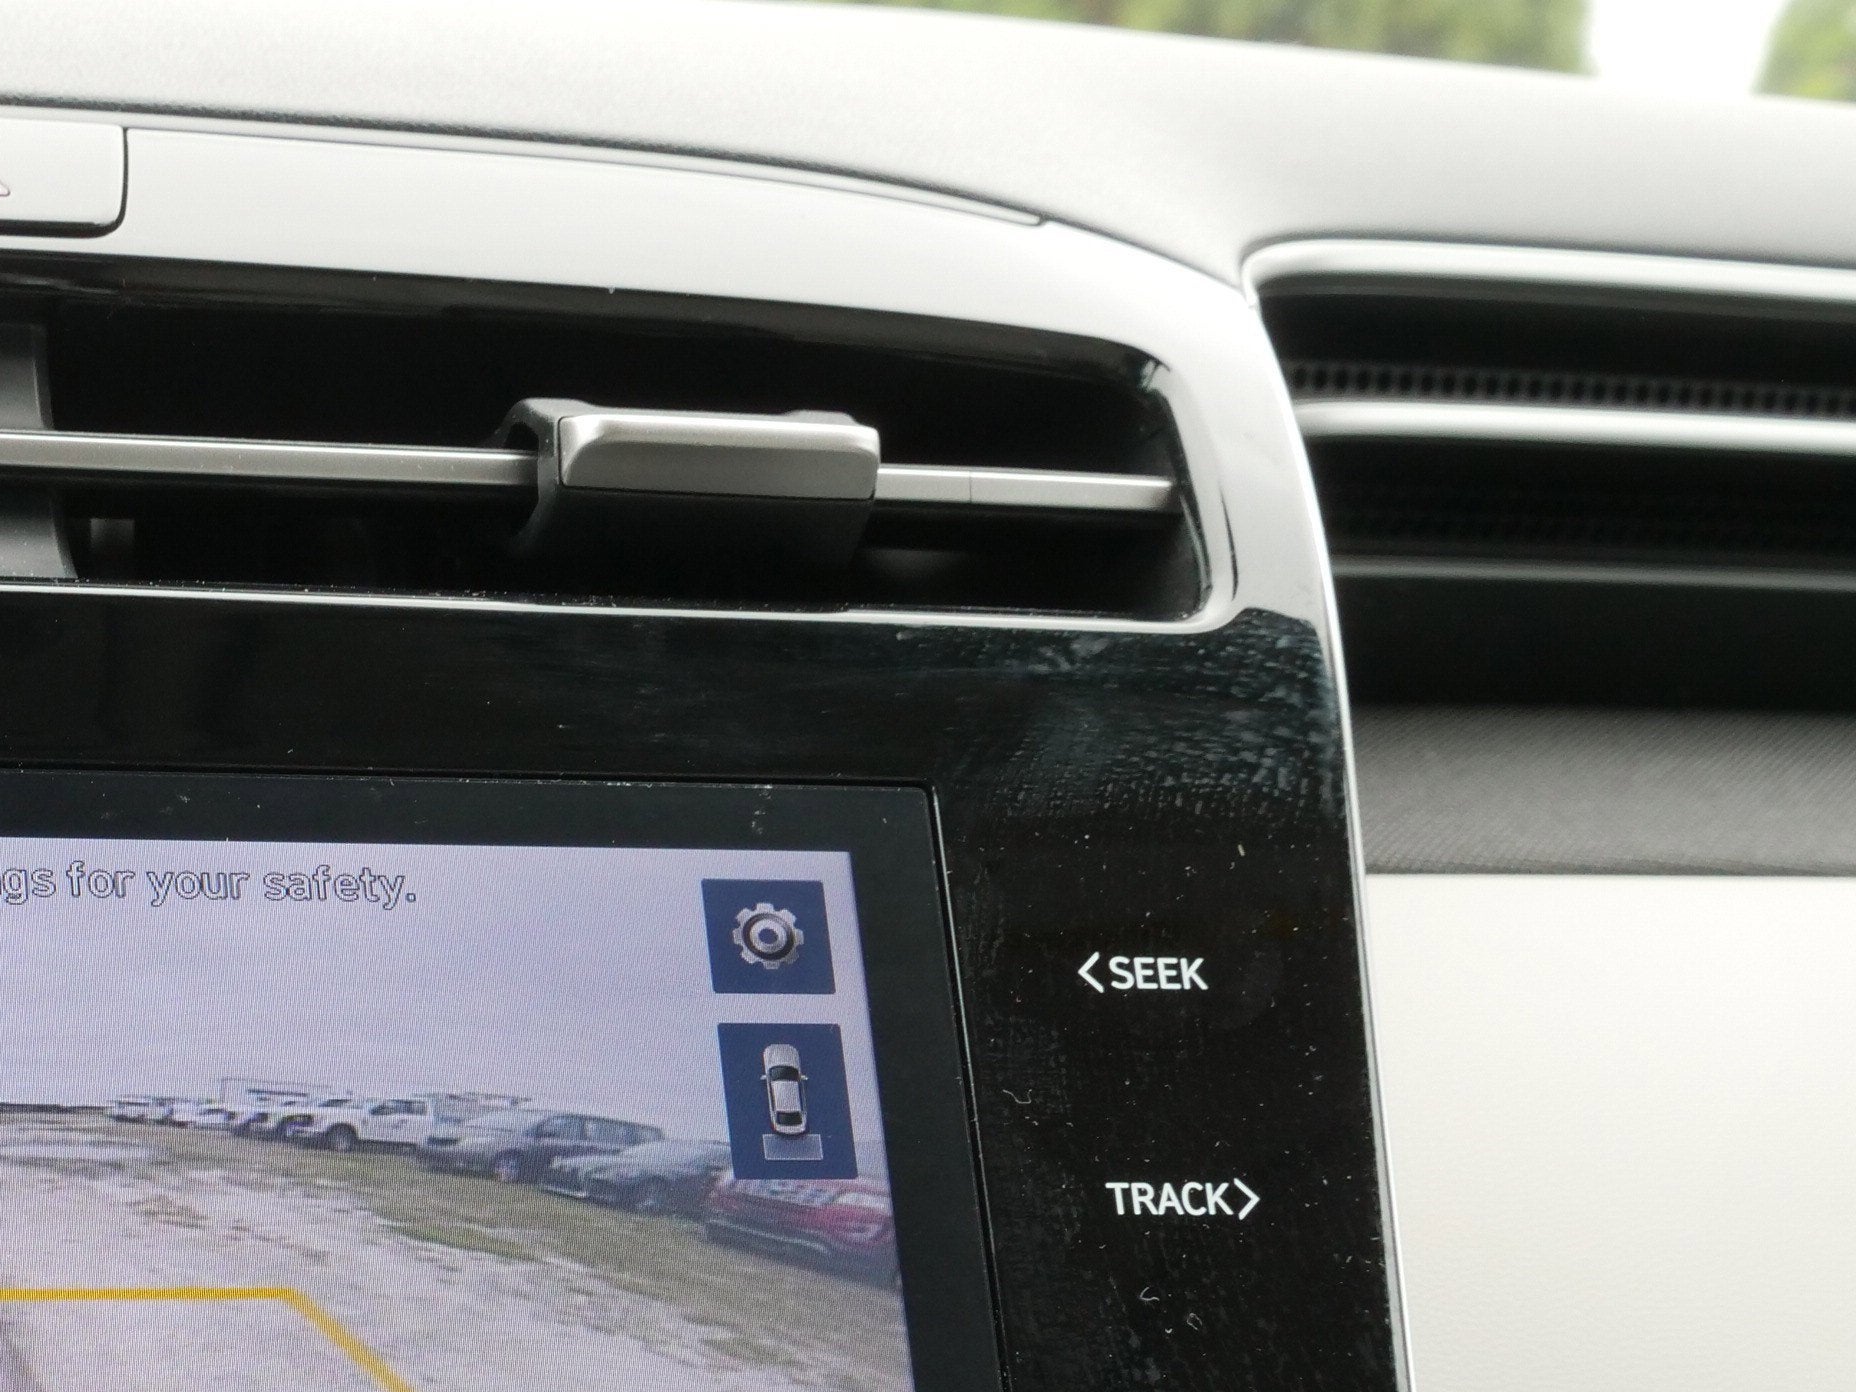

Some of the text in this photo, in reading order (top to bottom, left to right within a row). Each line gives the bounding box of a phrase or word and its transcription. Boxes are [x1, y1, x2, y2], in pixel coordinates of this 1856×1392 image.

[67, 860, 135, 899] for
[146, 869, 251, 908] your
[263, 864, 417, 911] safety.
